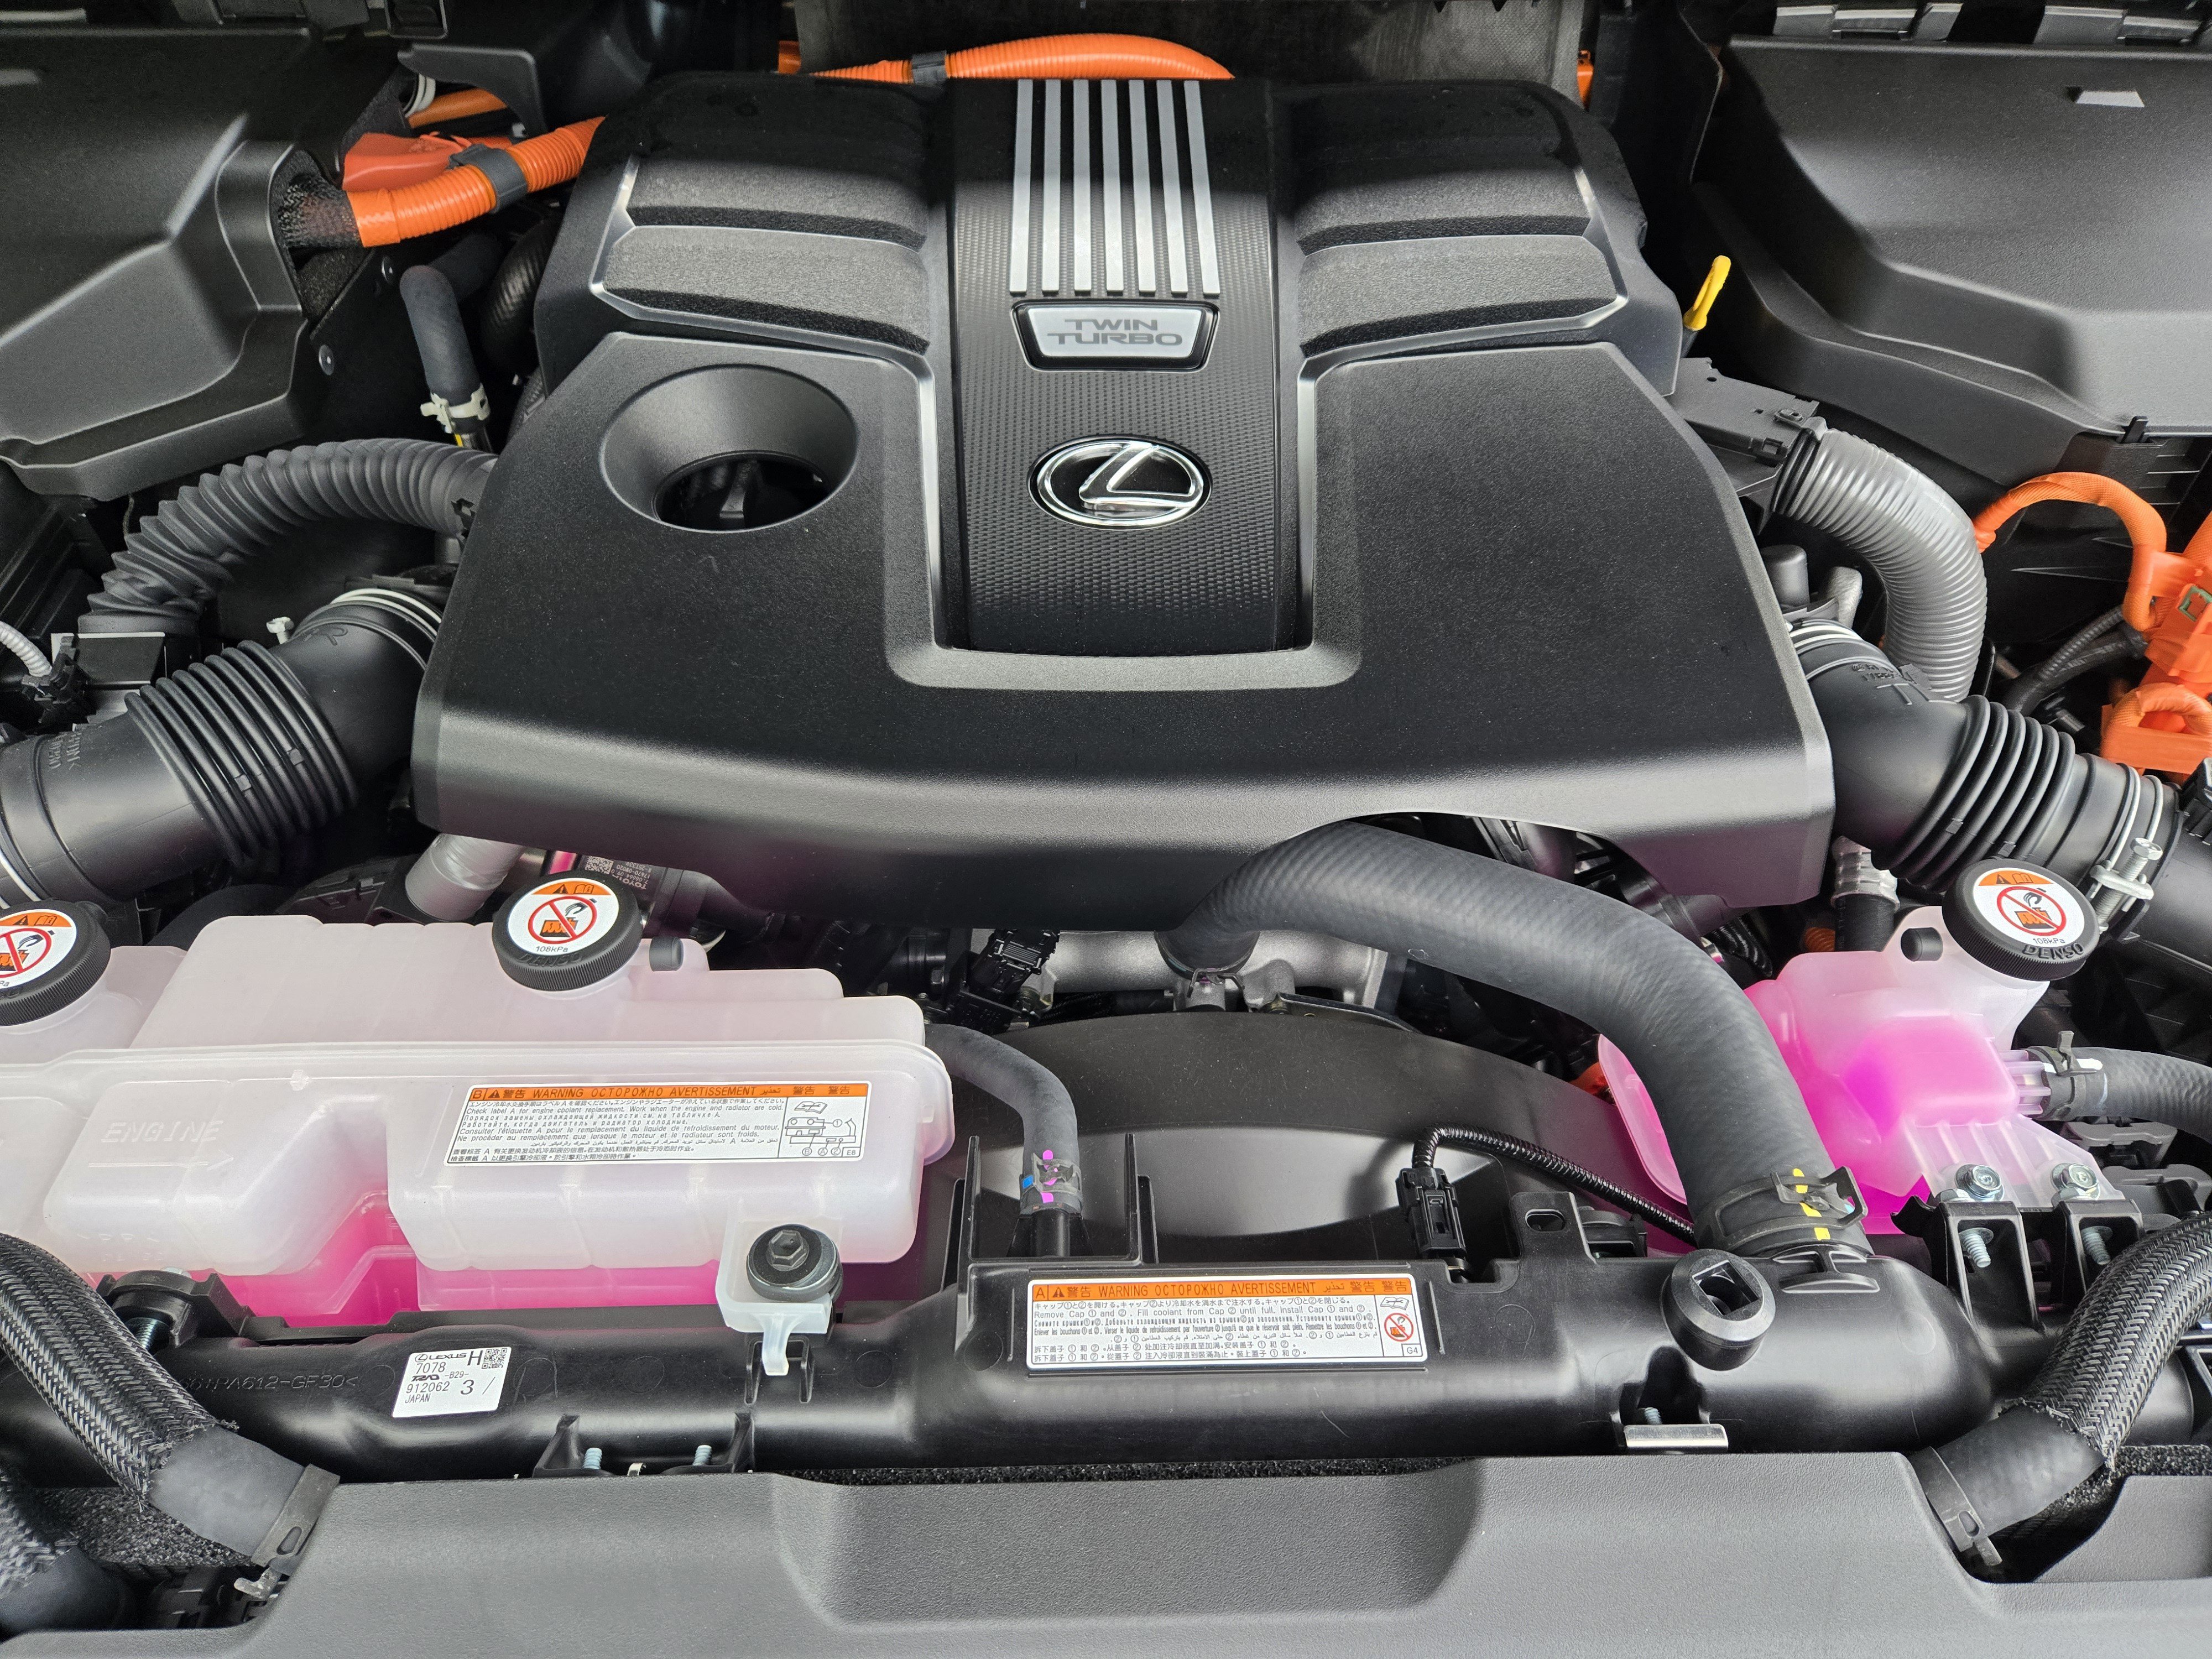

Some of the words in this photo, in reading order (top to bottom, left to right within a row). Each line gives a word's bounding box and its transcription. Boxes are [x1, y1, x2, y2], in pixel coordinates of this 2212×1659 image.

[1065, 319, 1158, 331] TWIN
[1047, 333, 1182, 346] TURBO
[2023, 942, 2084, 959] DENSO
[472, 1090, 482, 1099] B
[504, 1089, 526, 1099] 警告
[533, 1088, 584, 1098] WARNING
[591, 1087, 663, 1098] ОСТОРОЖНО
[669, 1086, 757, 1097] AVERTISSEMENT
[759, 1086, 781, 1095] تحذير
[793, 1085, 815, 1096] 警告
[828, 1085, 849, 1094] 警告
[101, 1120, 224, 1142] ENGINE
[1035, 1287, 1045, 1298] A
[1067, 1286, 1091, 1298] 警告
[1098, 1284, 1148, 1297] WARNING
[1155, 1283, 1224, 1296] ОСТОРОЖНО
[1231, 1282, 1316, 1295] AVERTISSEMENT
[1323, 1281, 1345, 1293] تحذير
[1350, 1280, 1375, 1292] 警告
[1382, 1280, 1407, 1292] 警告
[1209, 1307, 1224, 1316] Cap
[1239, 1307, 1256, 1316] until
[467, 1350, 483, 1365] H
[416, 1362, 446, 1374] 7078
[406, 1381, 450, 1394] 912062
[460, 1379, 474, 1395] 3
[405, 1393, 431, 1404] JAPAN
